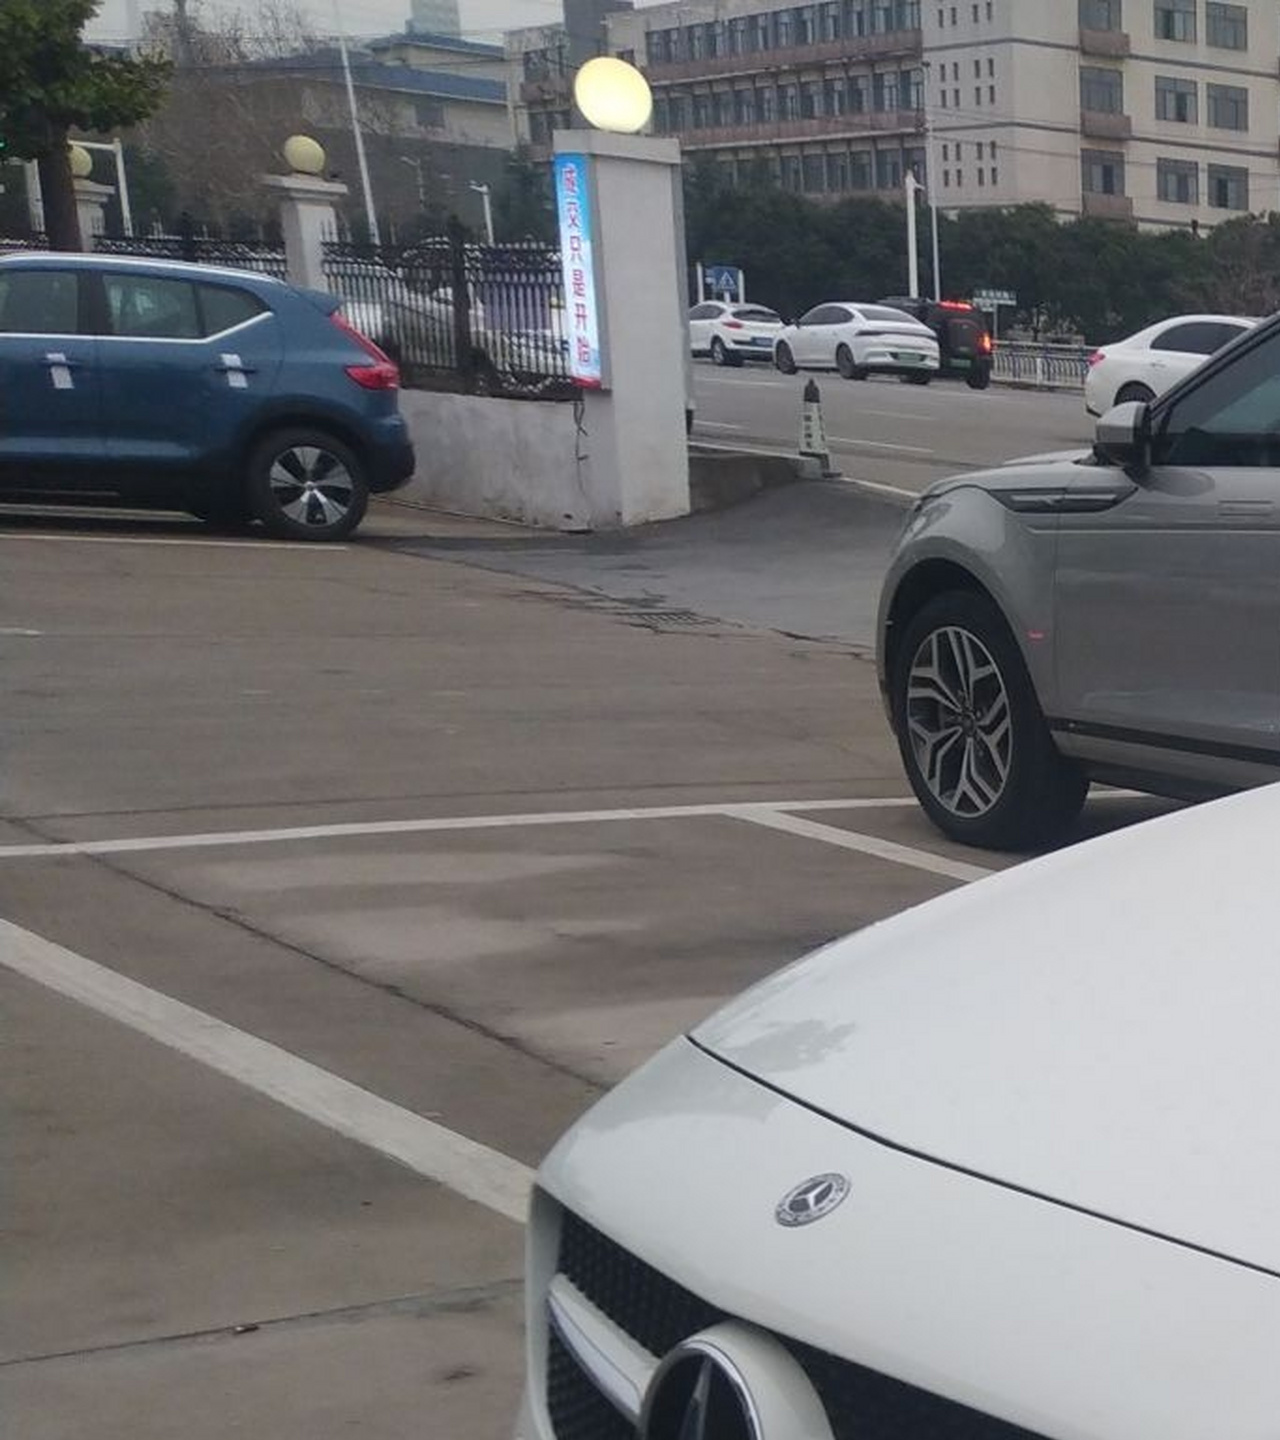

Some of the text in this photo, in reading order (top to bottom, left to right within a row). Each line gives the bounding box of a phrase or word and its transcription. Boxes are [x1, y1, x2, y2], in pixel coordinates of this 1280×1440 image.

[562, 163, 591, 364] 成交只是开始
